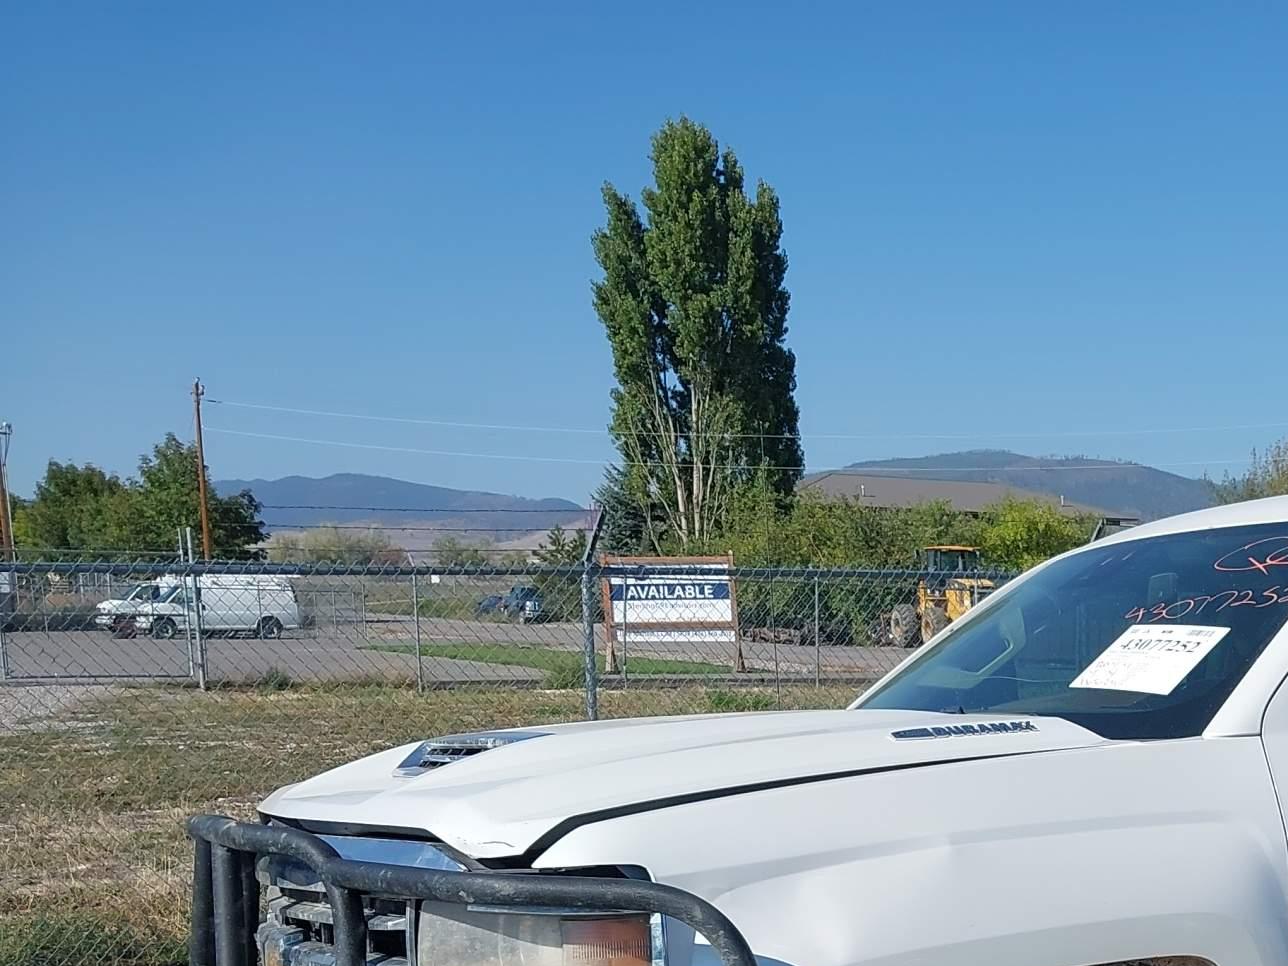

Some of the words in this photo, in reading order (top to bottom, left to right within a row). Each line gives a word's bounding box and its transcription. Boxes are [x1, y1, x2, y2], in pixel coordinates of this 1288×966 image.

[626, 584, 715, 600] AVAILABLE
[1120, 638, 1202, 653] 43077252
[931, 720, 1038, 737] DURAMAX
